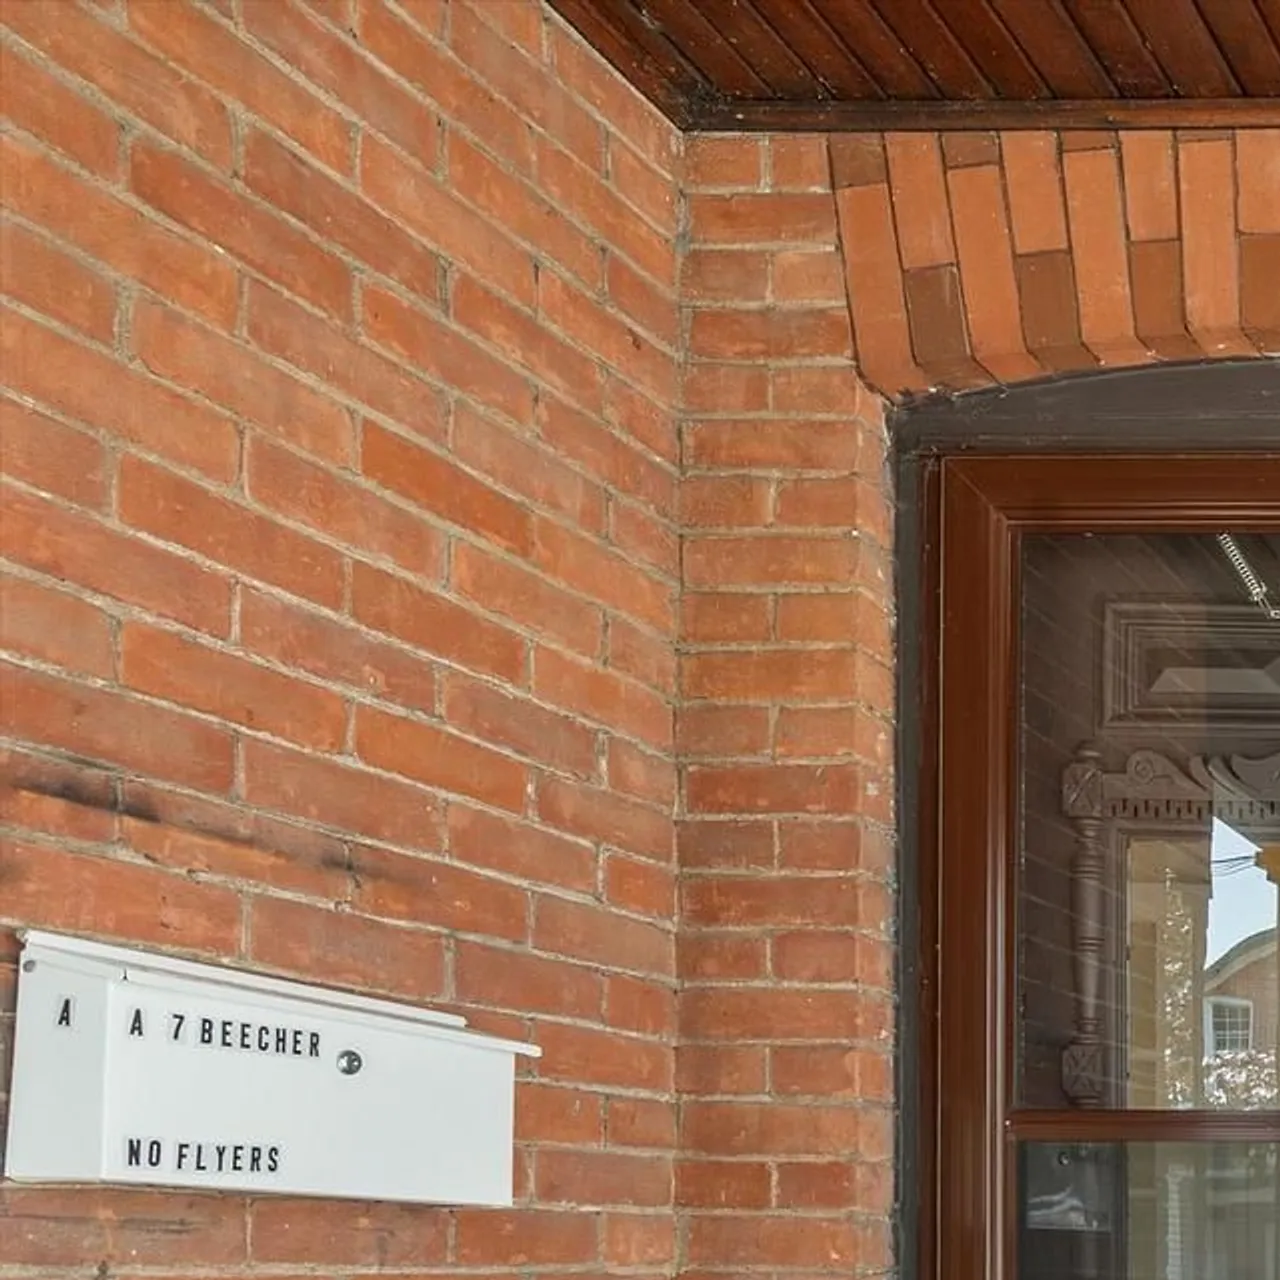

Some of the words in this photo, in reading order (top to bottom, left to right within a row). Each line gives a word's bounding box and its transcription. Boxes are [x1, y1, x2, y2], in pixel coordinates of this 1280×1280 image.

[58, 998, 72, 1027] A
[130, 1008, 144, 1037] A
[172, 1014, 185, 1041] 7
[200, 1018, 321, 1057] BEECHER
[127, 1138, 162, 1167] NO
[176, 1143, 280, 1173] FLYERS
